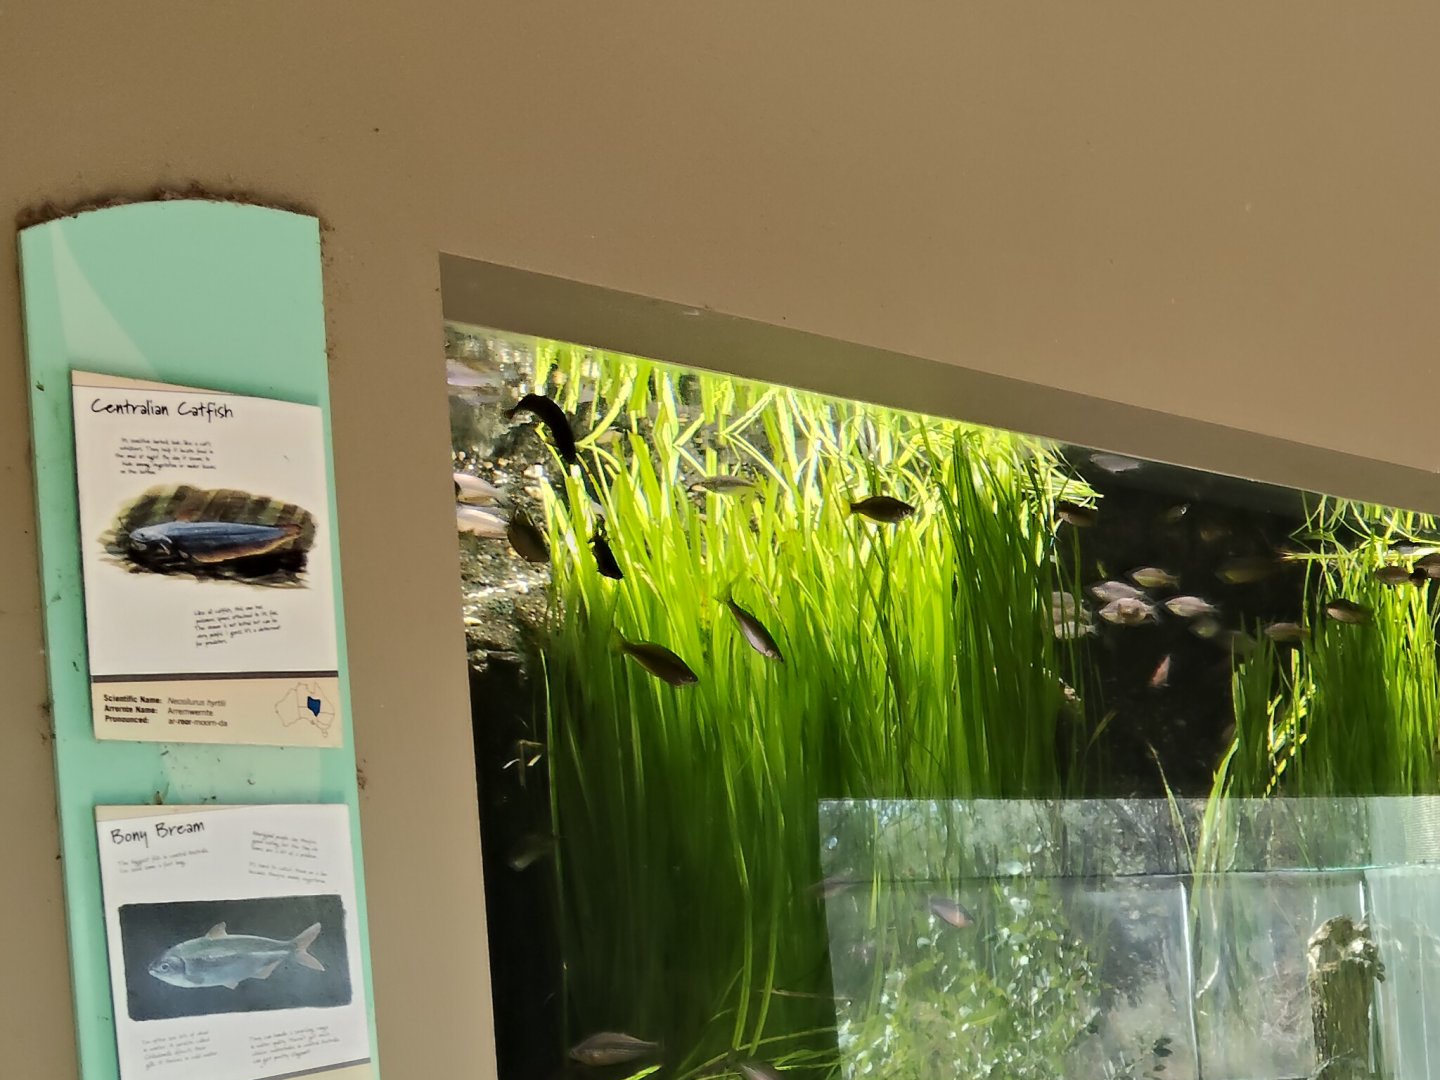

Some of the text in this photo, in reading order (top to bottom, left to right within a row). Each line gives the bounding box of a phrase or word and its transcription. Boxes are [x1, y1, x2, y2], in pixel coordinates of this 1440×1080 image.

[91, 399, 234, 423] Centralian Catfish
[110, 822, 204, 848] Bony Bream
